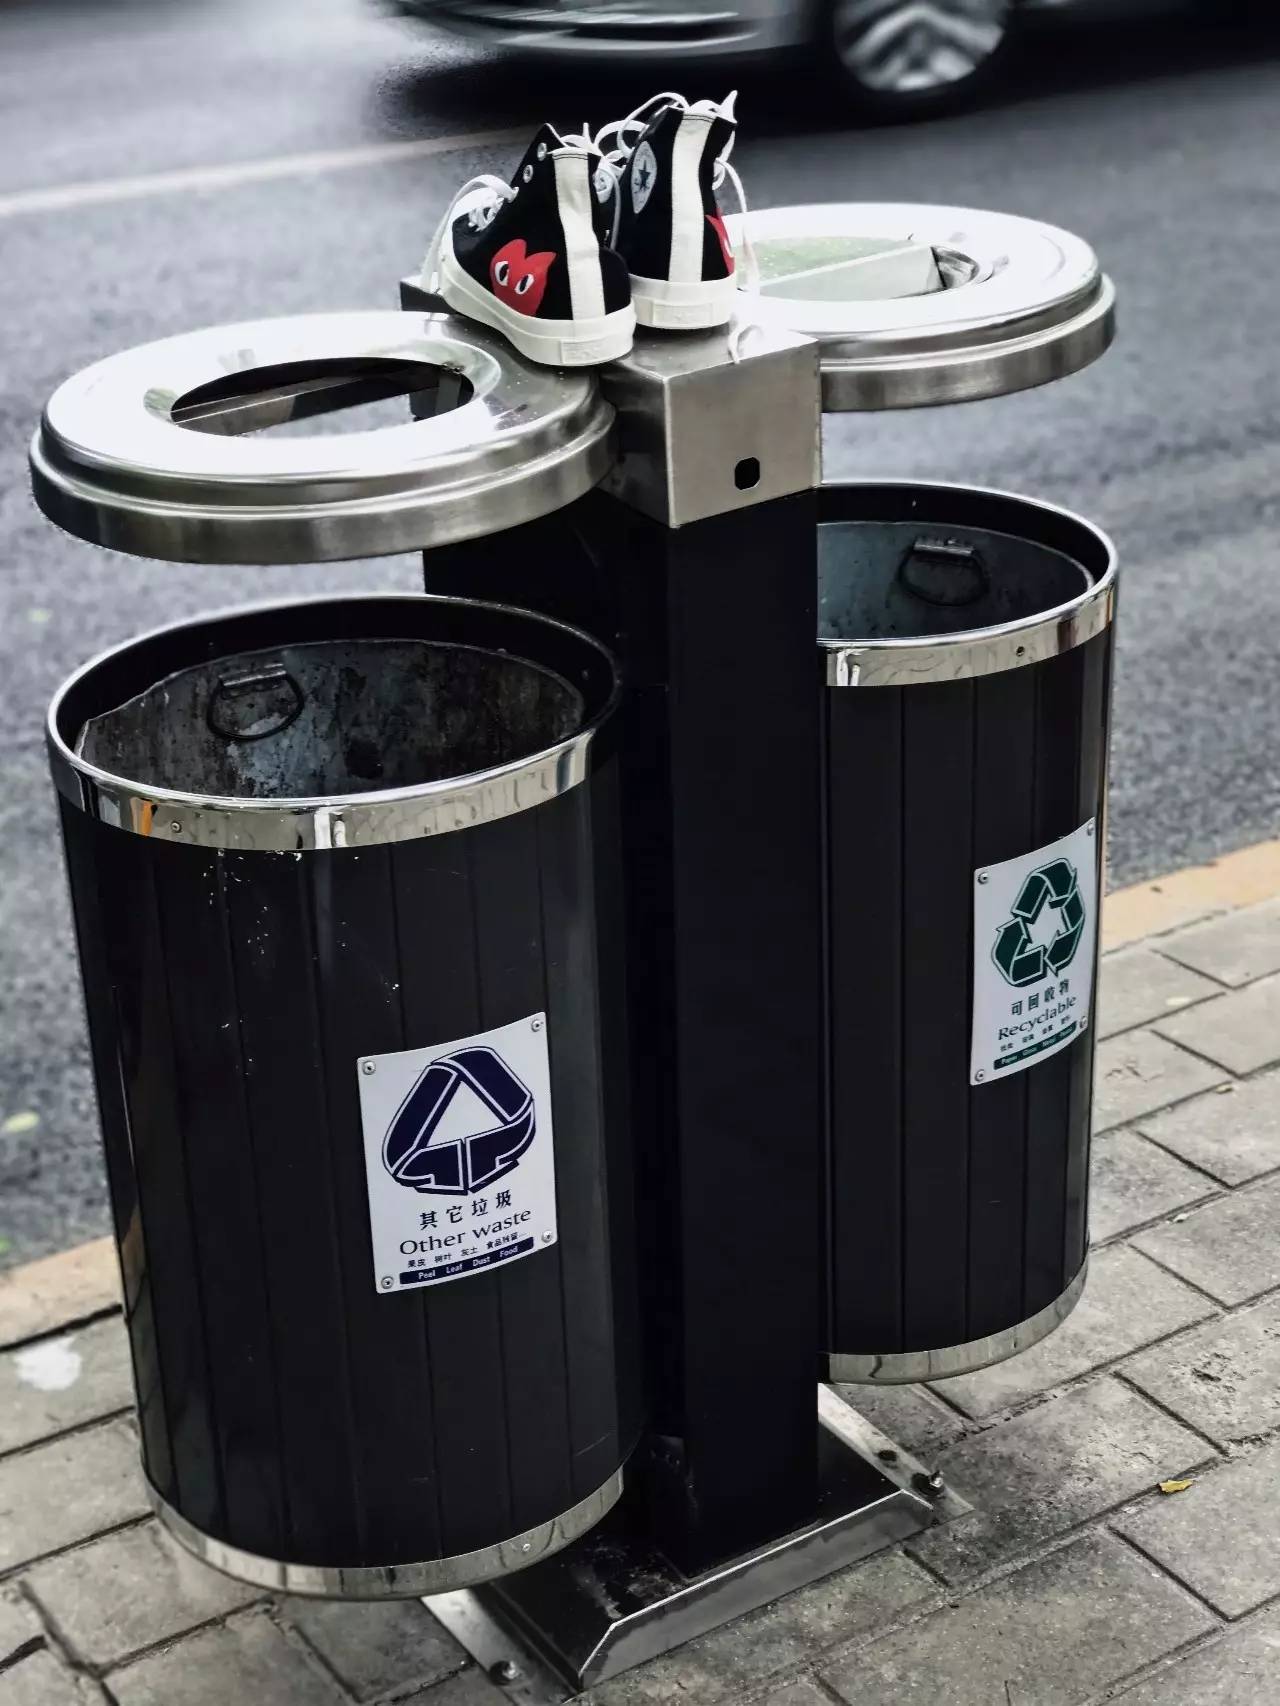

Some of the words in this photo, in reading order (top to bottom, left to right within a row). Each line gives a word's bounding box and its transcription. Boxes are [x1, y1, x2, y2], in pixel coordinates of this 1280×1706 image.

[998, 997, 1076, 1040] Recyclable
[419, 1189, 512, 1231] 其它垃圾
[400, 1232, 466, 1255] Other
[472, 1210, 531, 1239] waste
[418, 1270, 436, 1280] Peel
[446, 1264, 463, 1274] Leaf
[472, 1256, 491, 1267] Dust
[500, 1246, 519, 1258] Food
